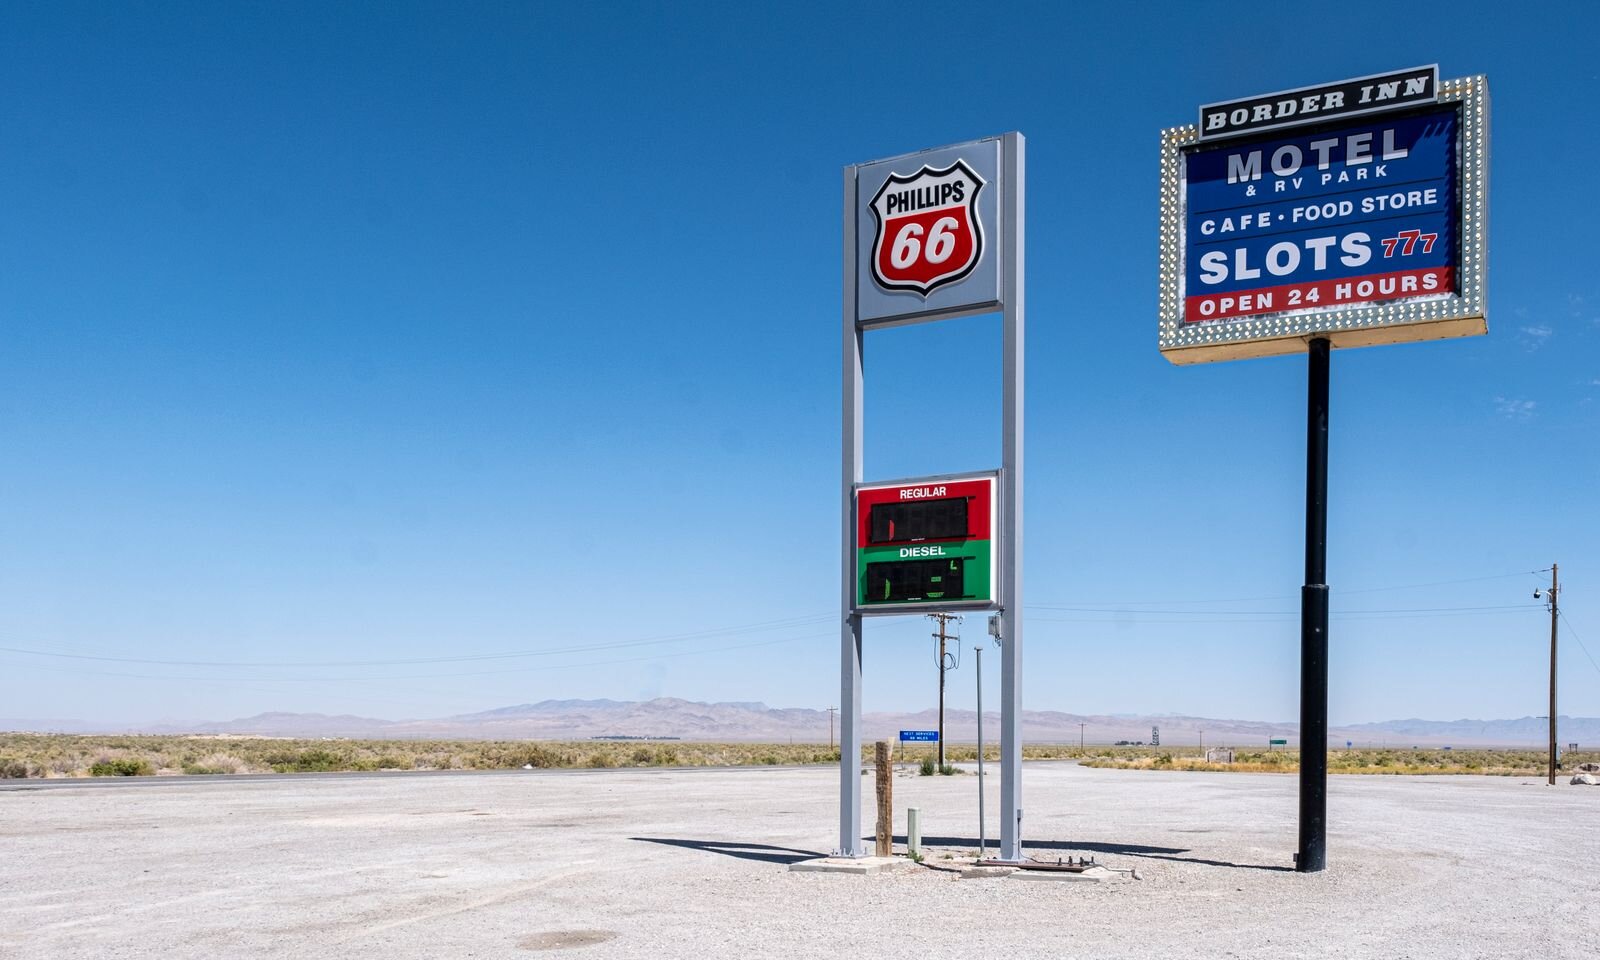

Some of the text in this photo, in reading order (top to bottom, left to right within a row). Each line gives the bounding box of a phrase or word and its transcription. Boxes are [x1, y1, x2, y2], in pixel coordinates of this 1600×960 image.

[1206, 75, 1430, 131] BORDER INN
[1226, 128, 1408, 185] MOTEL
[886, 180, 965, 215] PHILLIPS
[1245, 165, 1387, 197] & RV PARK
[1200, 188, 1438, 236] CAFE FOOD STORE
[890, 216, 959, 270] 66
[1199, 229, 1438, 285] SLOTS 777
[1199, 273, 1438, 316] OPEN 24 HOURS
[900, 486, 947, 499] REGULAR
[900, 545, 946, 558] DIESEL
